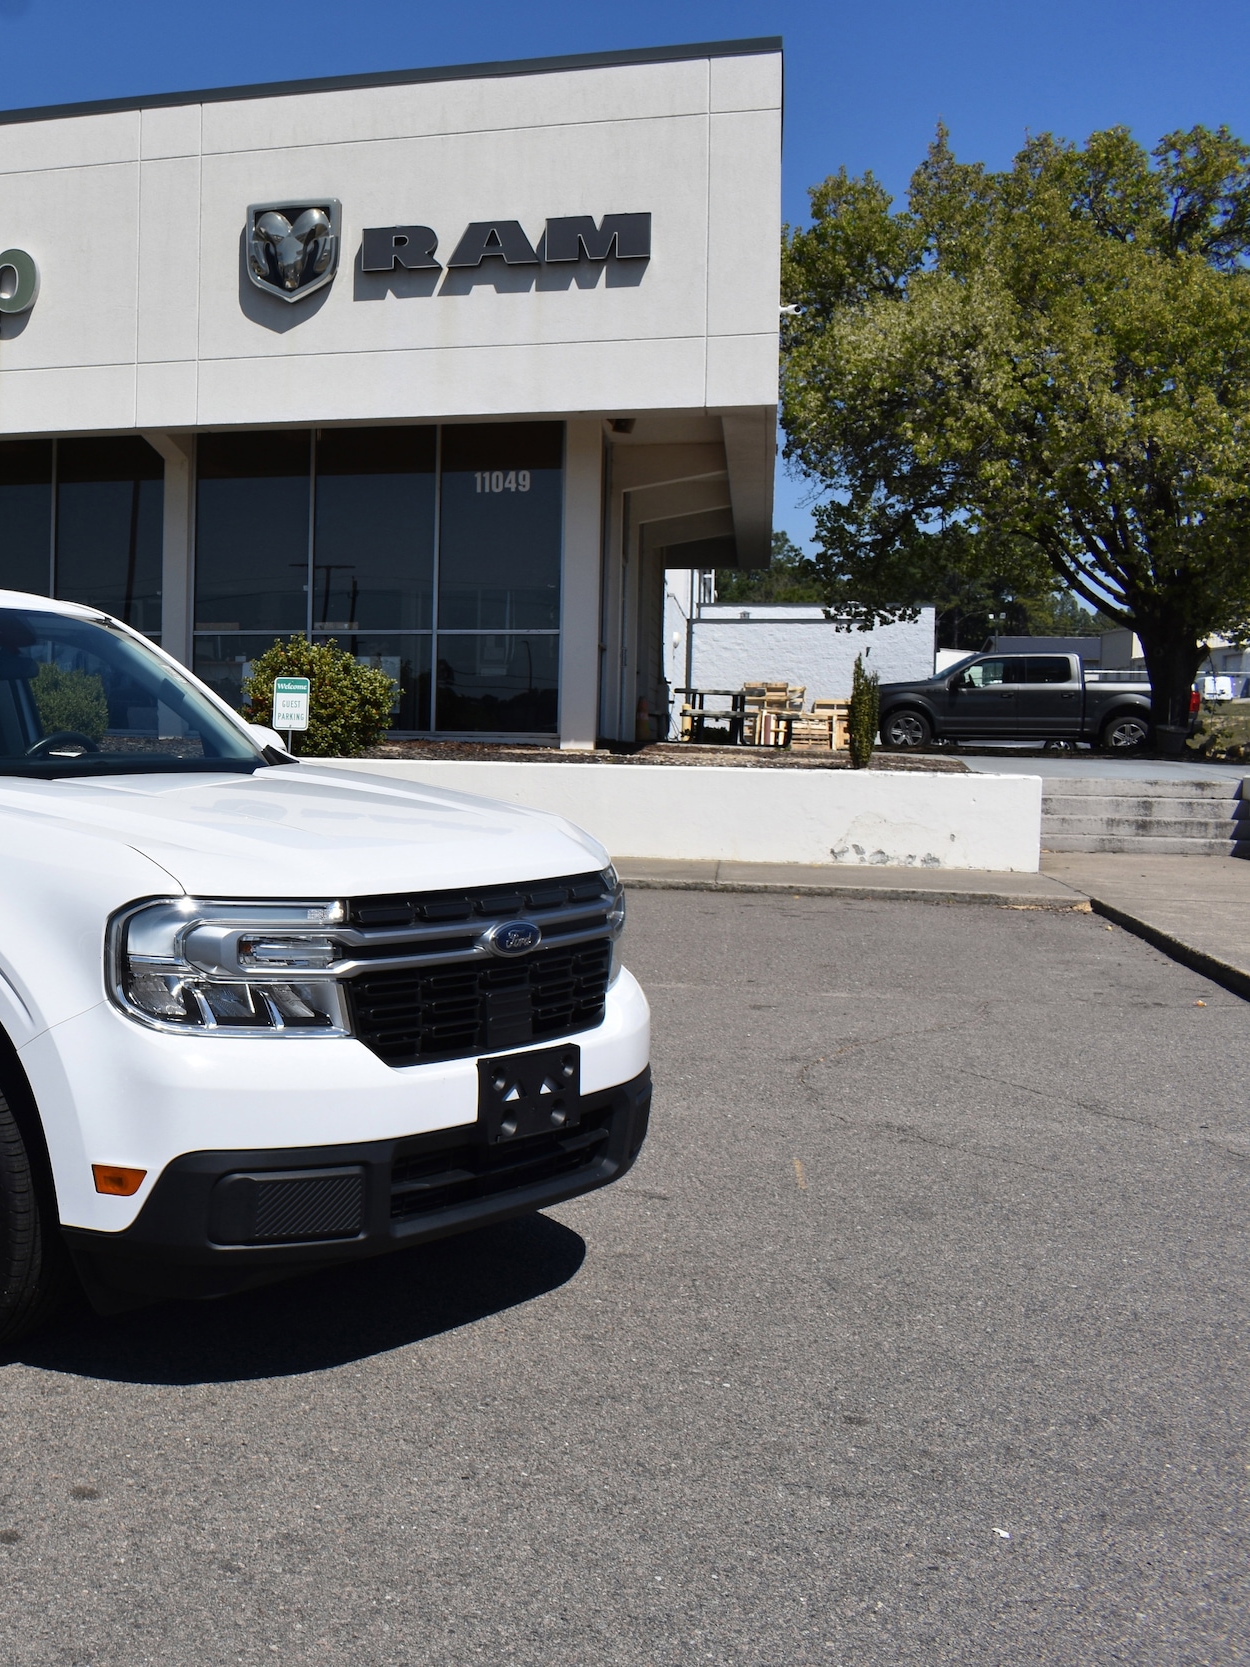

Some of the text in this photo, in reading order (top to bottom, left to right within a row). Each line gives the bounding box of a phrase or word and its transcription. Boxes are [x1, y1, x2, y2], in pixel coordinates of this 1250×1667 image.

[362, 212, 652, 272] RAM
[474, 470, 531, 493] 11049
[277, 682, 307, 690] Welcome
[282, 700, 301, 708] GUEST
[277, 713, 304, 721] PARKING
[505, 929, 532, 949] Ford
